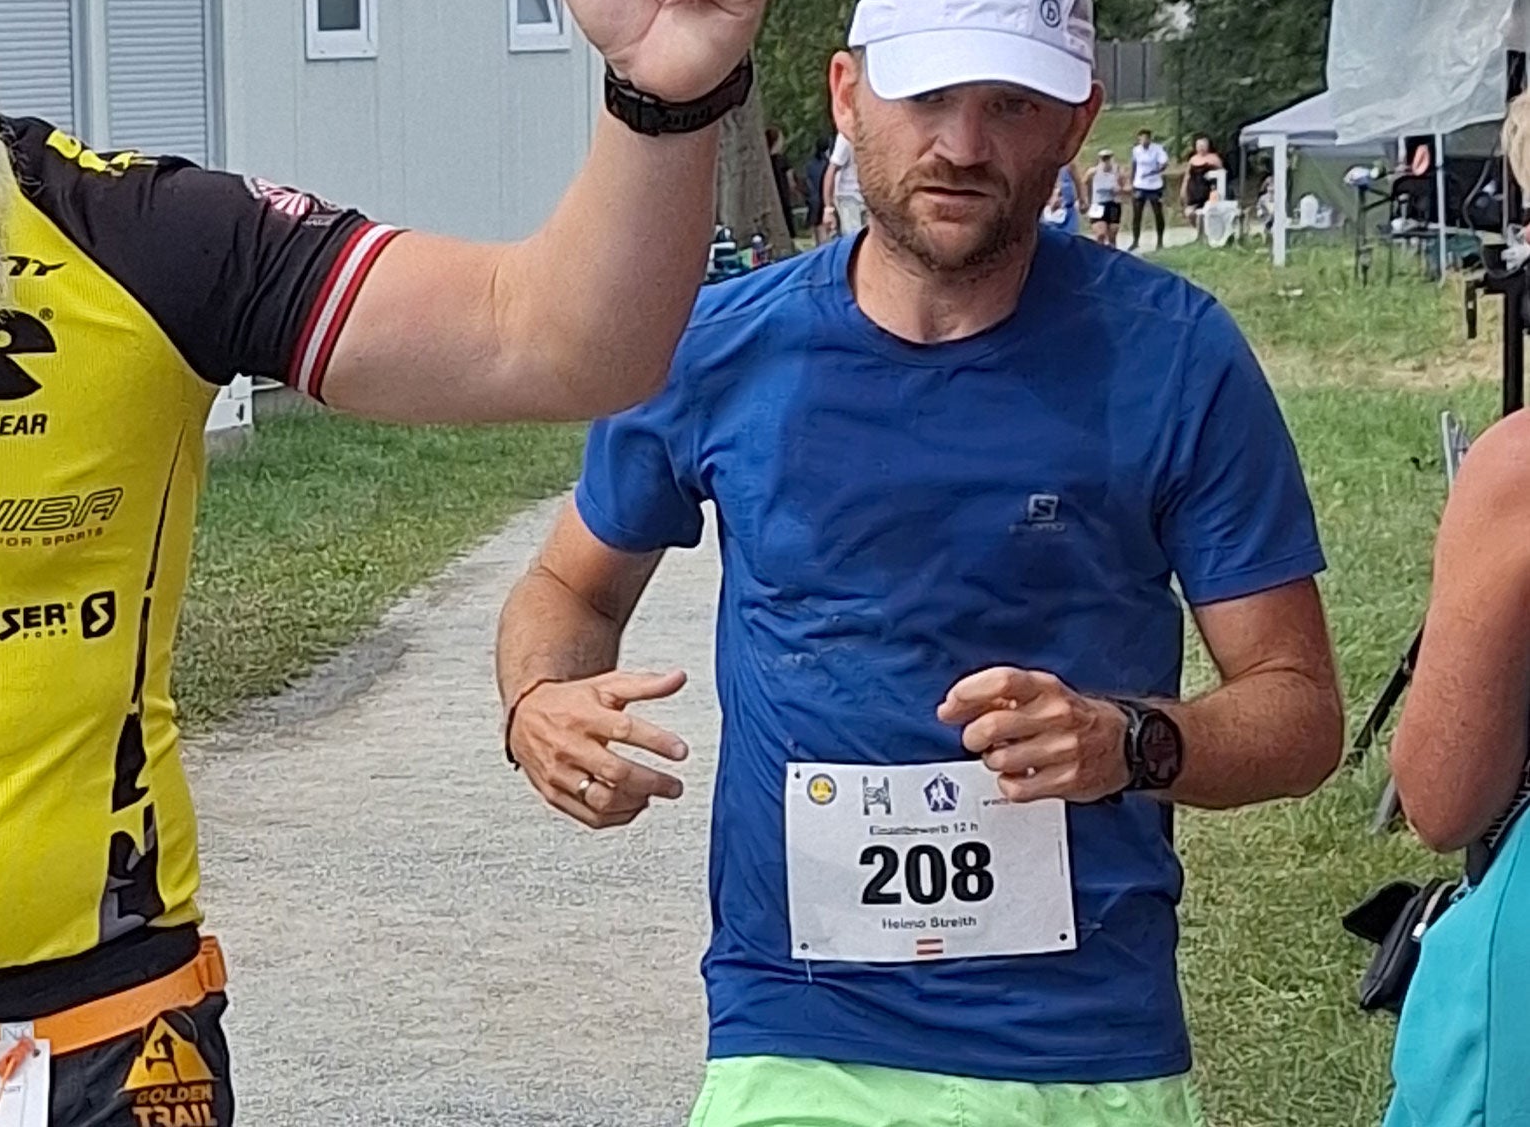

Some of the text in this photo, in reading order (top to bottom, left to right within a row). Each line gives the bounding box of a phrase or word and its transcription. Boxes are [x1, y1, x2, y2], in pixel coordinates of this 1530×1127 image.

[42, 527, 104, 546] SPORTS
[953, 822, 967, 833] 12
[859, 841, 995, 906] 208
